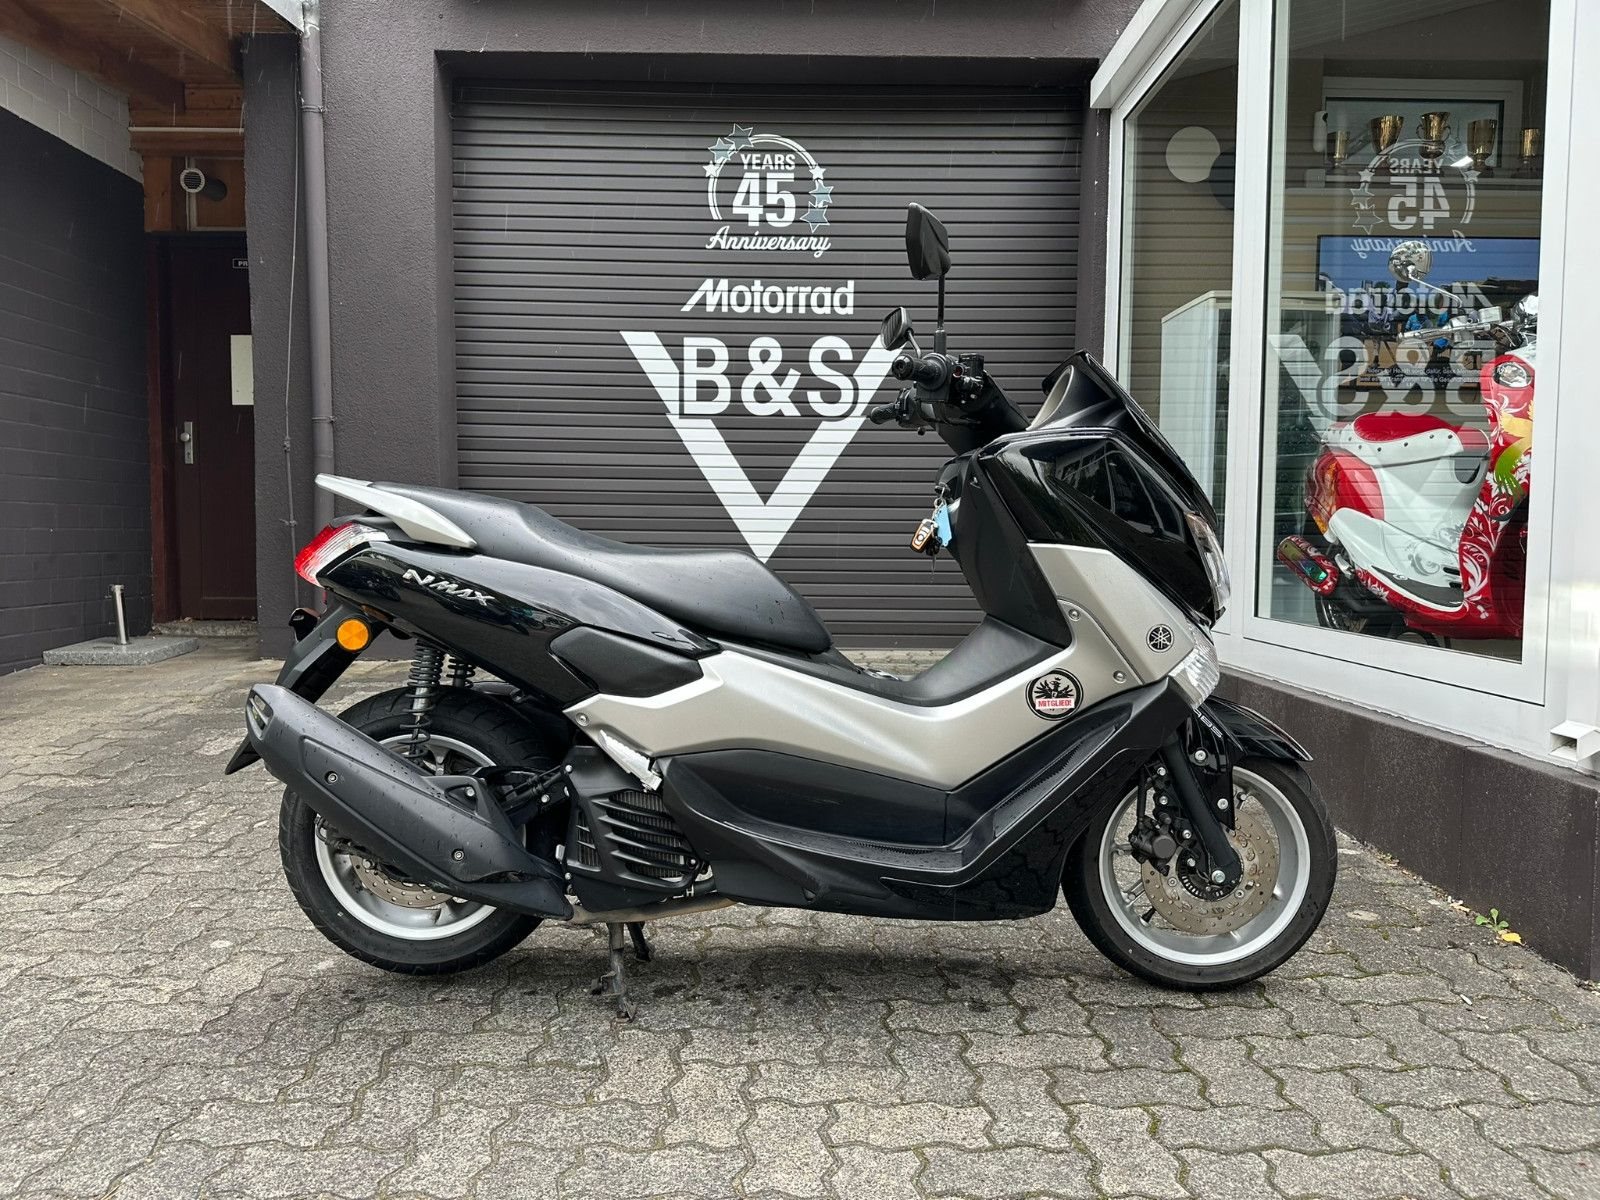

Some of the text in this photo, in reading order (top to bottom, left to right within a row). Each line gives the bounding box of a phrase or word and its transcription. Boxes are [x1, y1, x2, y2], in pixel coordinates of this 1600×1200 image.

[739, 153, 796, 171] YEARS
[732, 172, 796, 228] 45
[705, 225, 832, 259] Anniversary
[680, 279, 855, 315] Motorrad
[402, 568, 496, 607] NMAX
[1038, 700, 1072, 708] MITGLIED!
